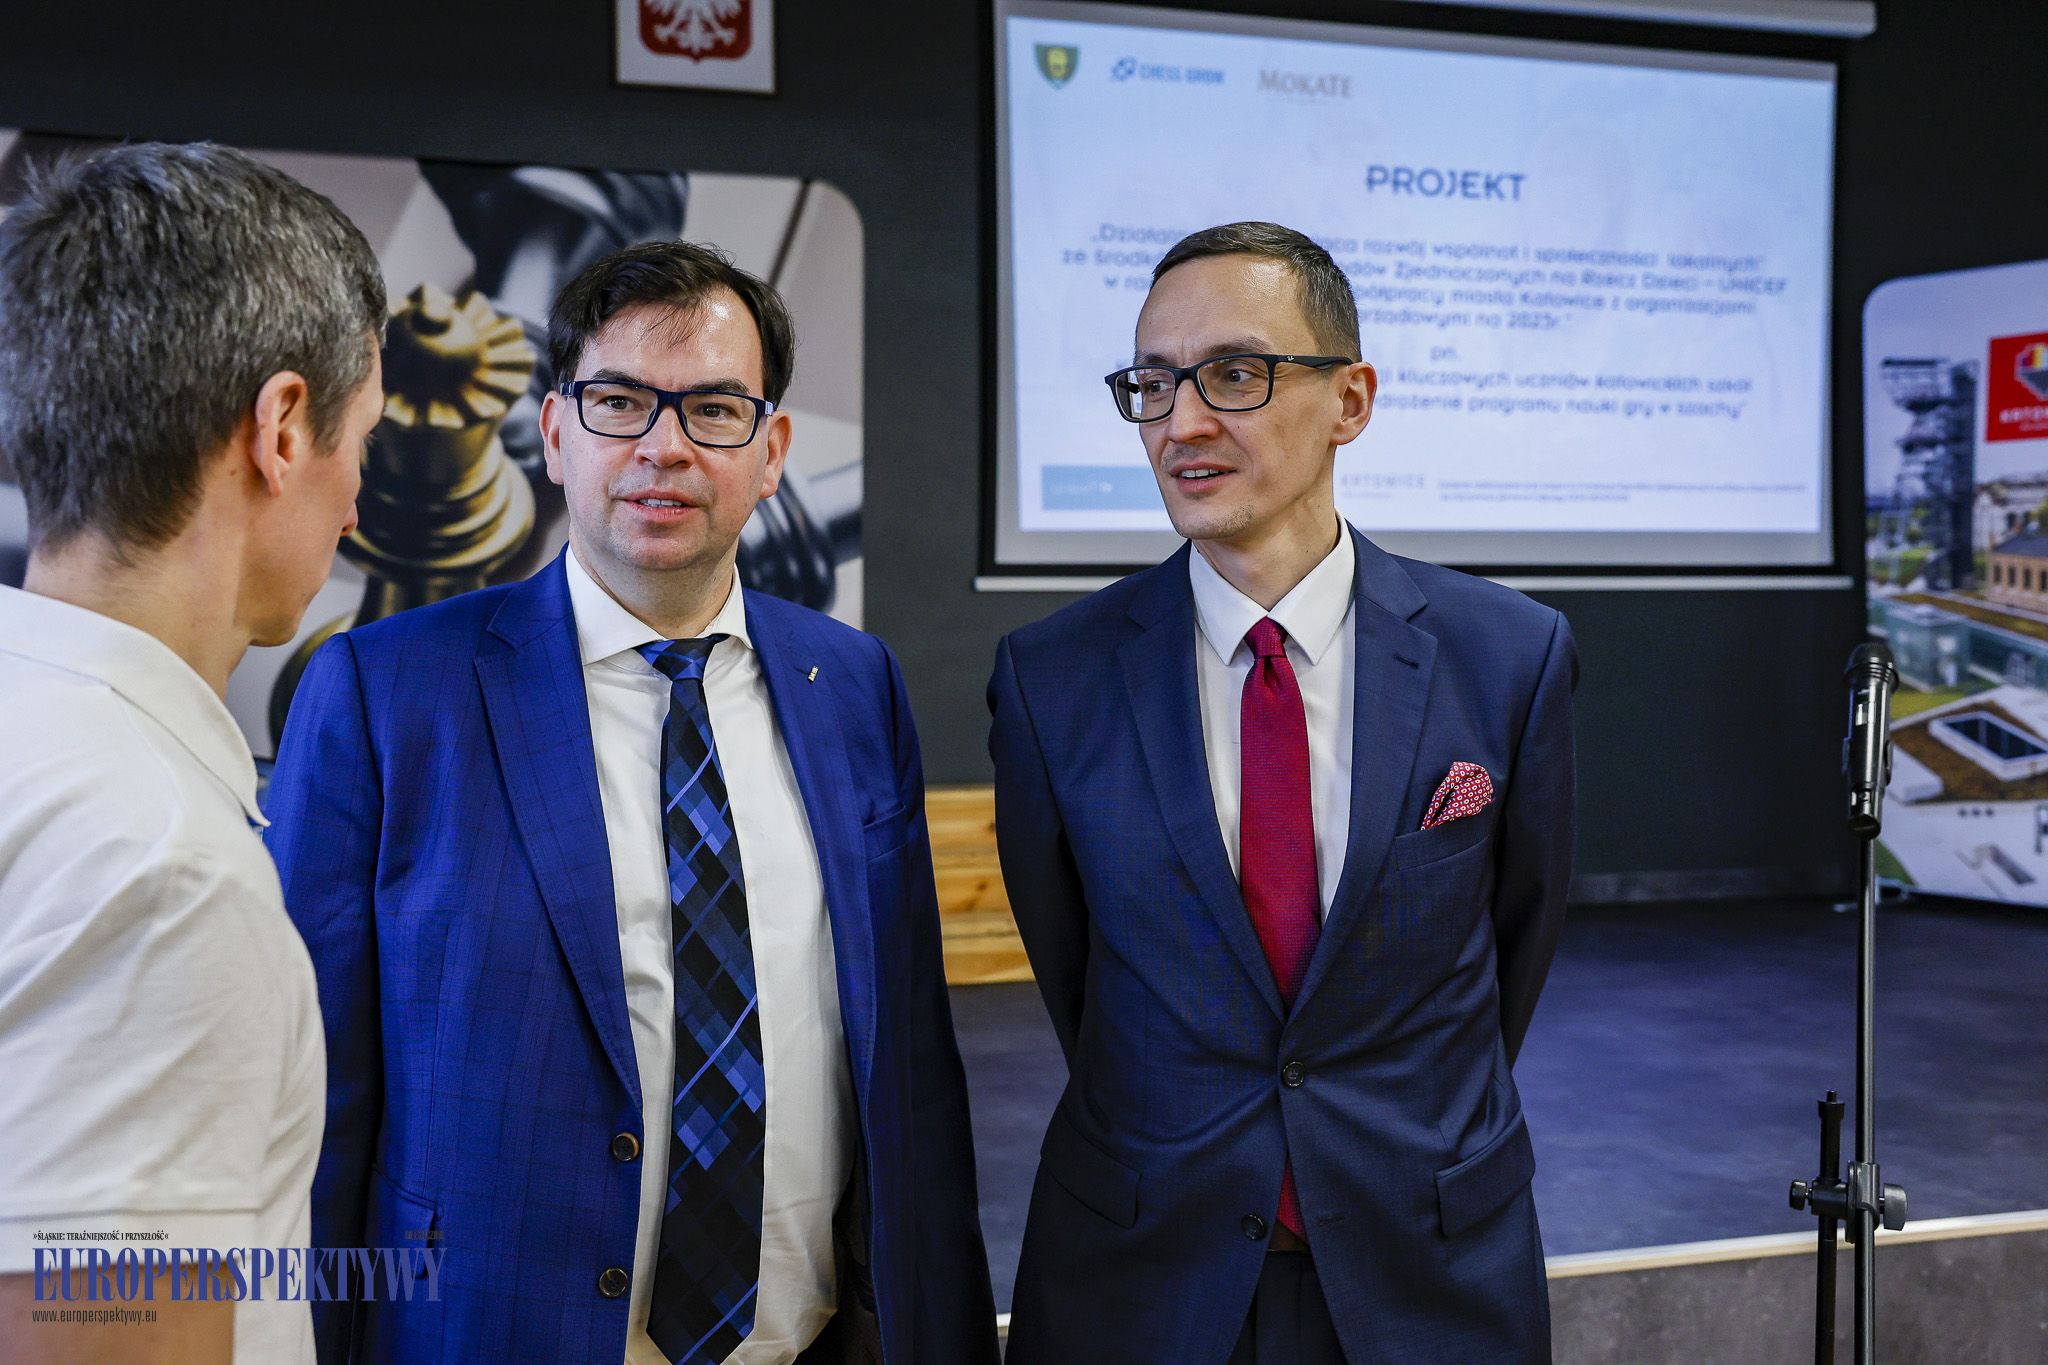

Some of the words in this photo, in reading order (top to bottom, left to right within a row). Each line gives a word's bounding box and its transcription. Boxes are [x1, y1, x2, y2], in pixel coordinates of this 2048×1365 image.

[1138, 64, 1181, 82] CHESS
[1366, 165, 1526, 201] PROJEKT
[1363, 237, 1426, 260] rozwój
[1431, 239, 1518, 262] wspólnot
[1534, 246, 1659, 267] społeczności
[1063, 248, 1088, 266] ze
[1394, 260, 1547, 286] Zjednoczonych
[1551, 270, 1577, 288] na
[1581, 268, 1635, 289] Rzecz
[1641, 271, 1699, 291] Dzieci
[1717, 276, 1787, 295] UNICEF
[1103, 276, 1120, 289] w
[1450, 290, 1515, 305] miasta
[1519, 290, 1606, 311] Katowice
[1624, 295, 1757, 317] organizacjami
[1473, 312, 1502, 329] na
[1398, 369, 1512, 390] kluczowych
[1515, 371, 1589, 390] uczniów
[1594, 374, 1703, 392] katowickich
[1707, 376, 1753, 393] szkół
[1467, 396, 1563, 415] programu
[1566, 398, 1618, 415] nauki
[1622, 399, 1654, 419] gry
